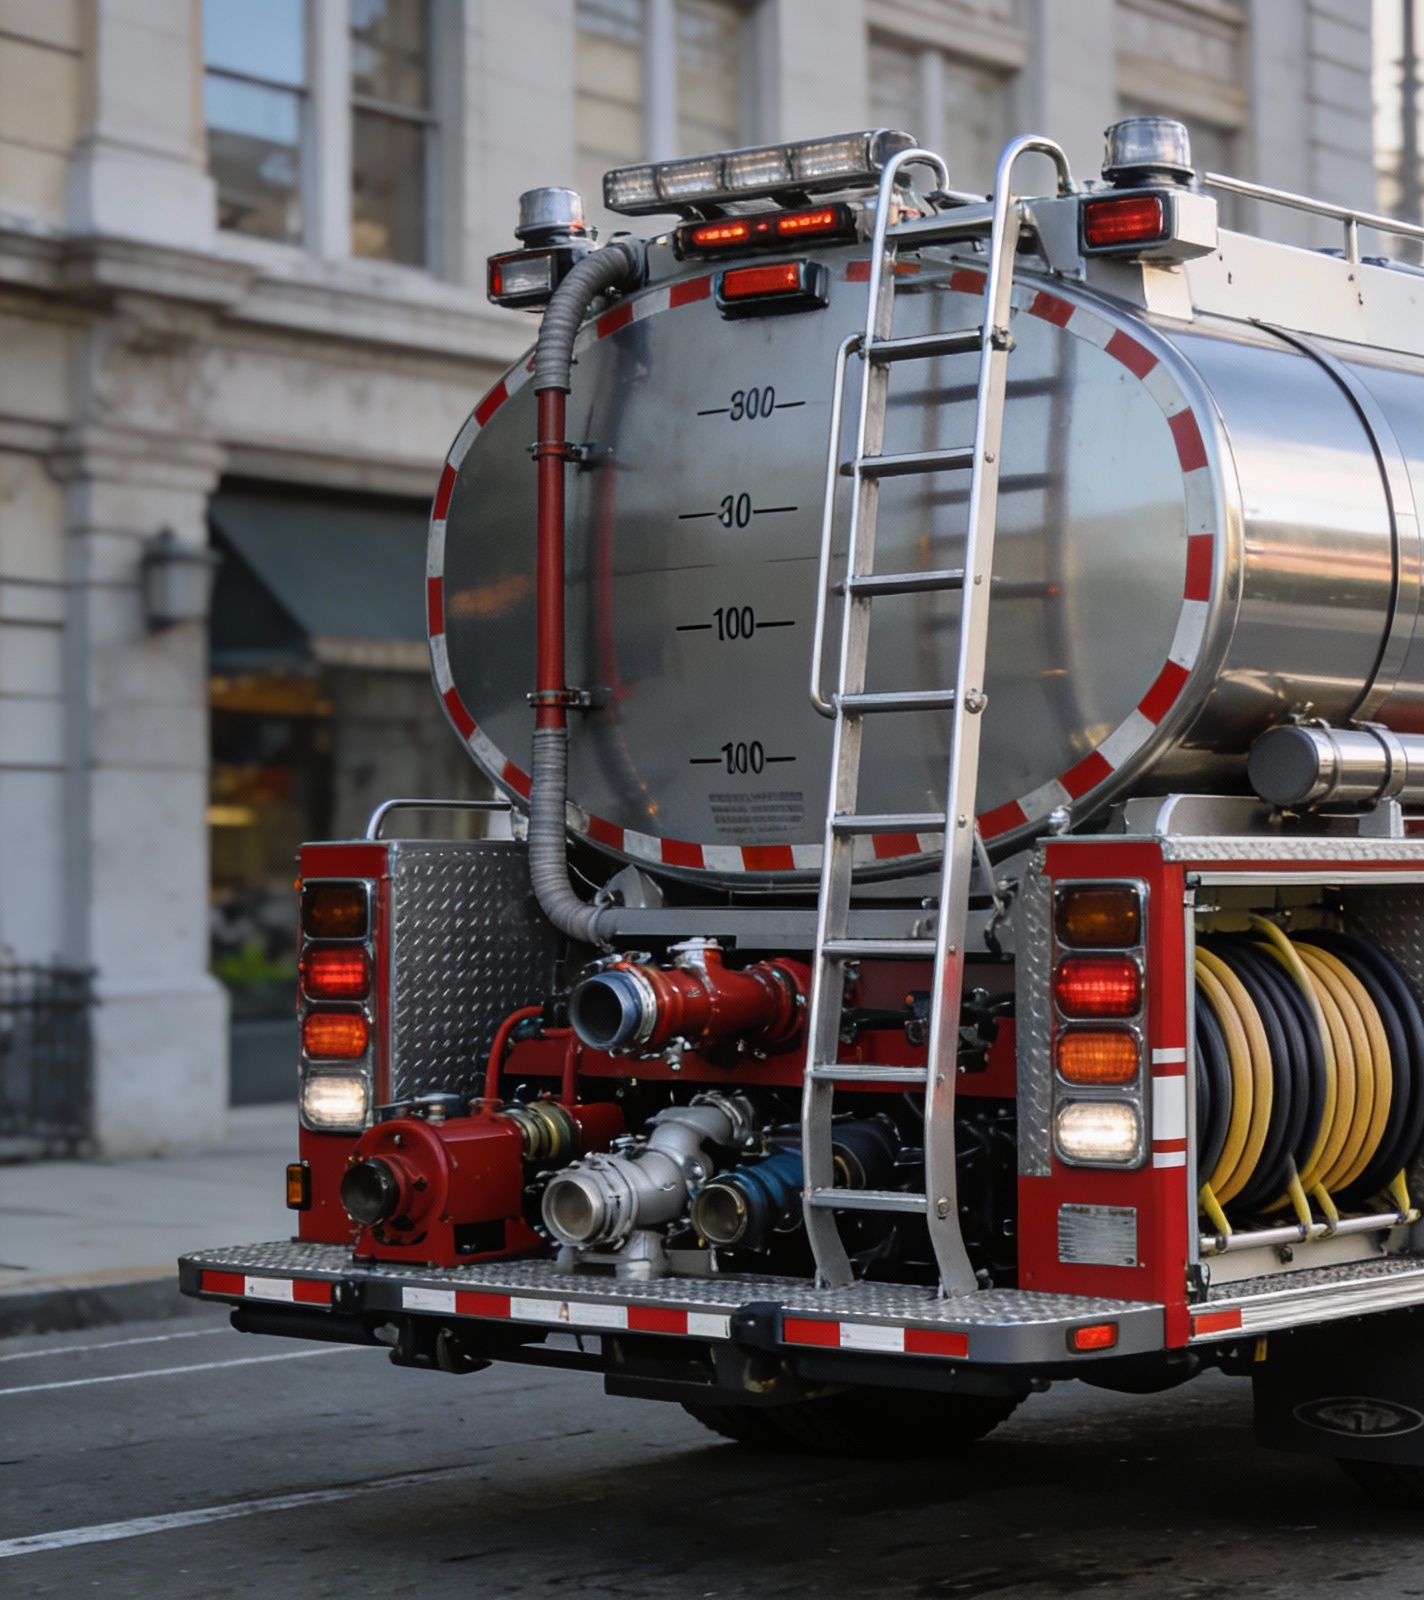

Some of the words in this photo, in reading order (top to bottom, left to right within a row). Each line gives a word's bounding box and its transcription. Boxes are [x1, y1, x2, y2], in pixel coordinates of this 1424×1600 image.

[730, 386, 775, 421] 300
[713, 606, 754, 641] 100
[722, 740, 764, 774] 100
